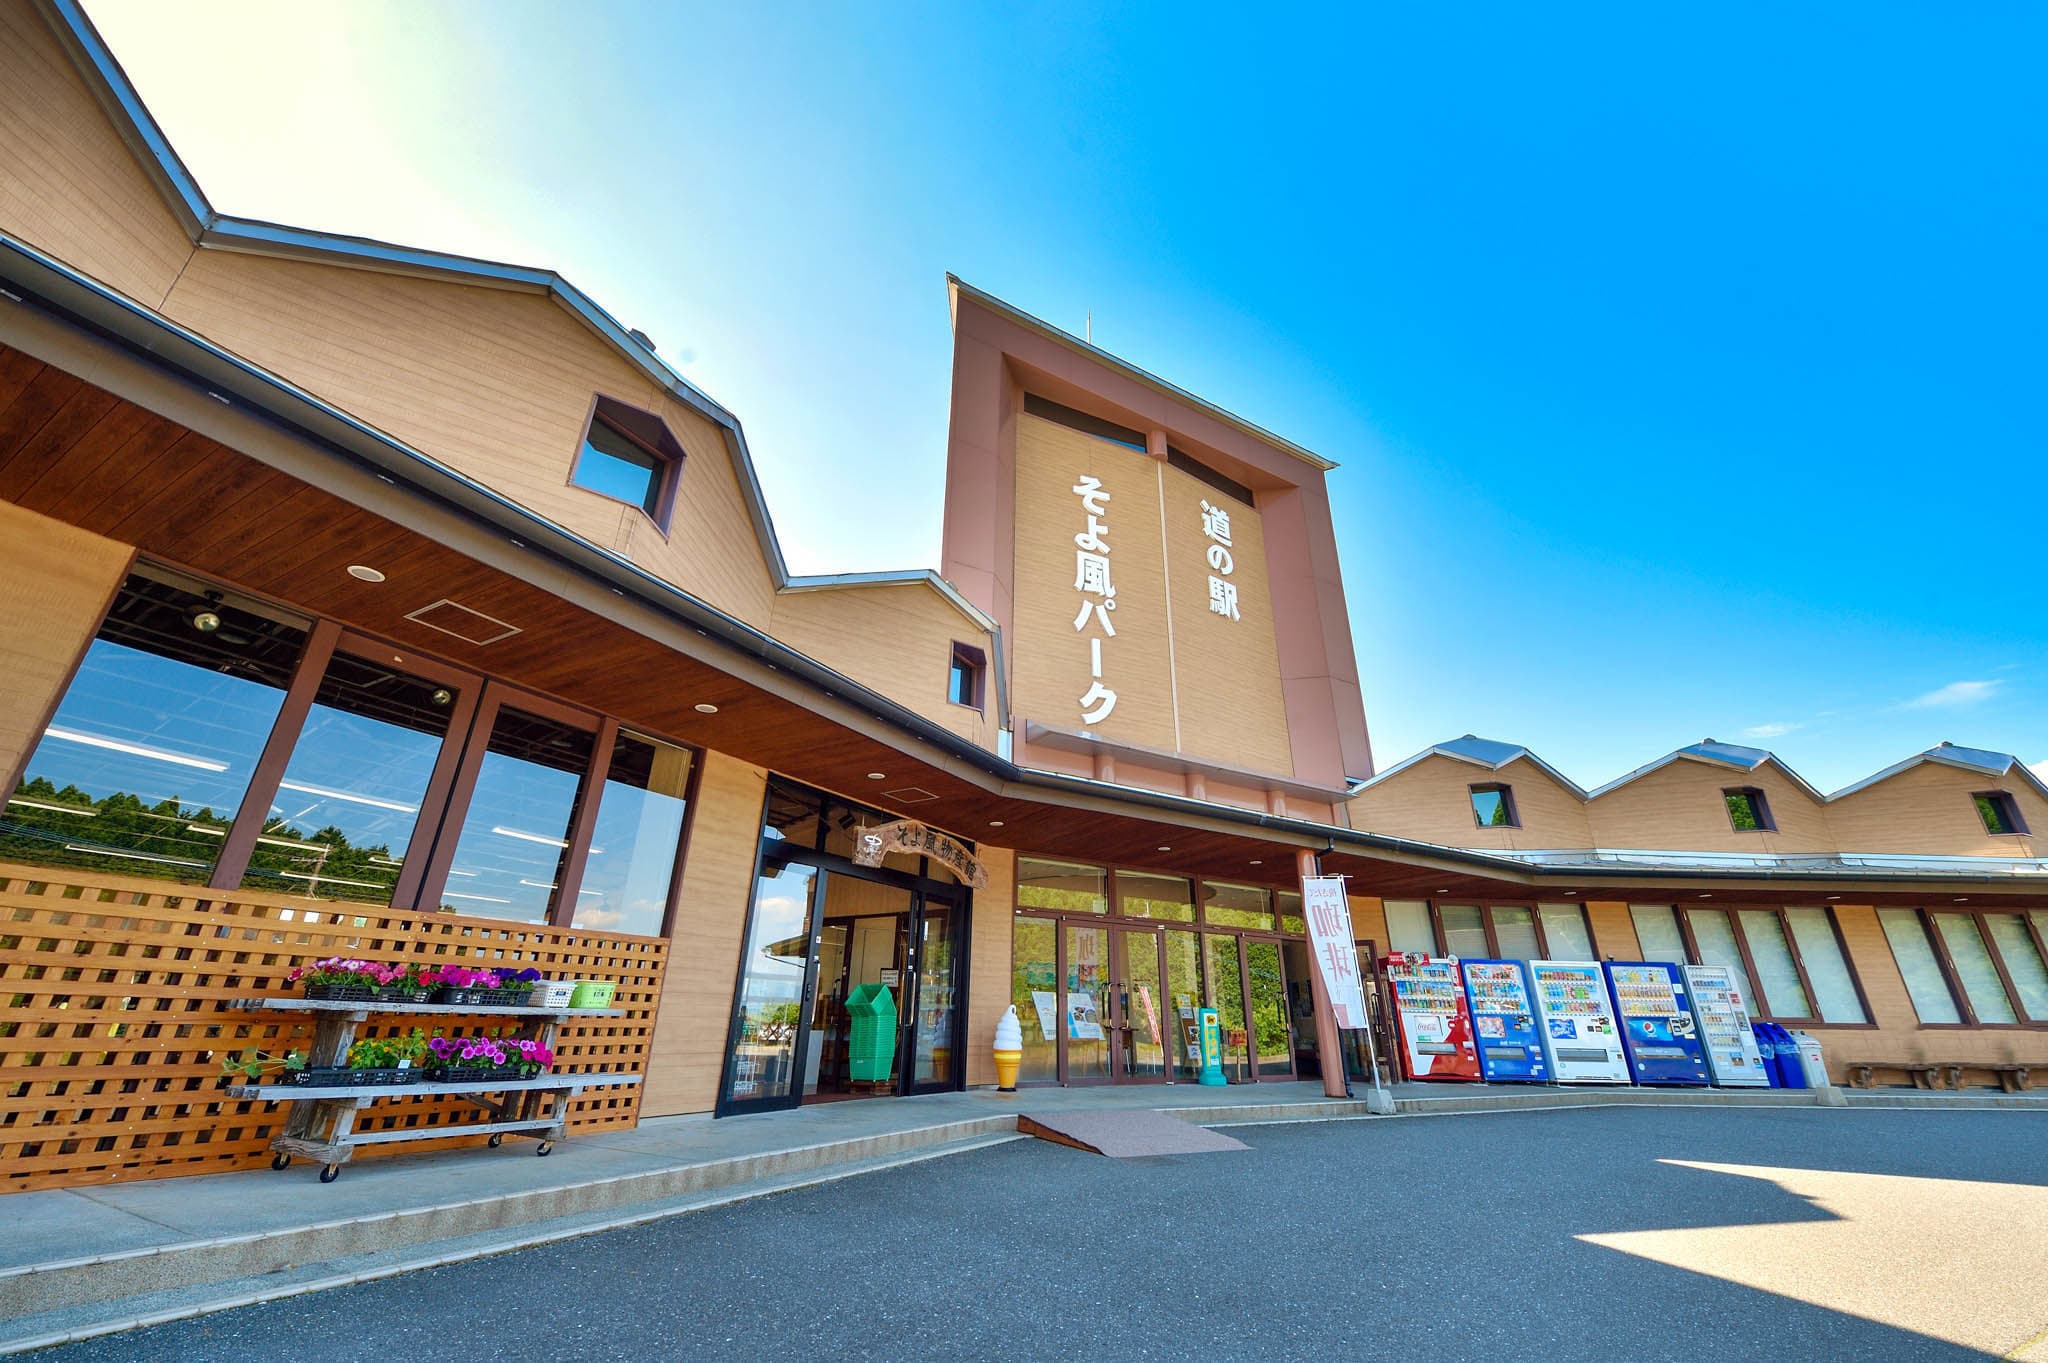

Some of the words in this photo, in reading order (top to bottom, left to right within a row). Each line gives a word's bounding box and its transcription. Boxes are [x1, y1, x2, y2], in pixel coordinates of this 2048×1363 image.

[1072, 475, 1118, 725] そよ風パーク
[1200, 499, 1241, 623] 道の駅
[897, 823, 977, 881] そよ風物産館
